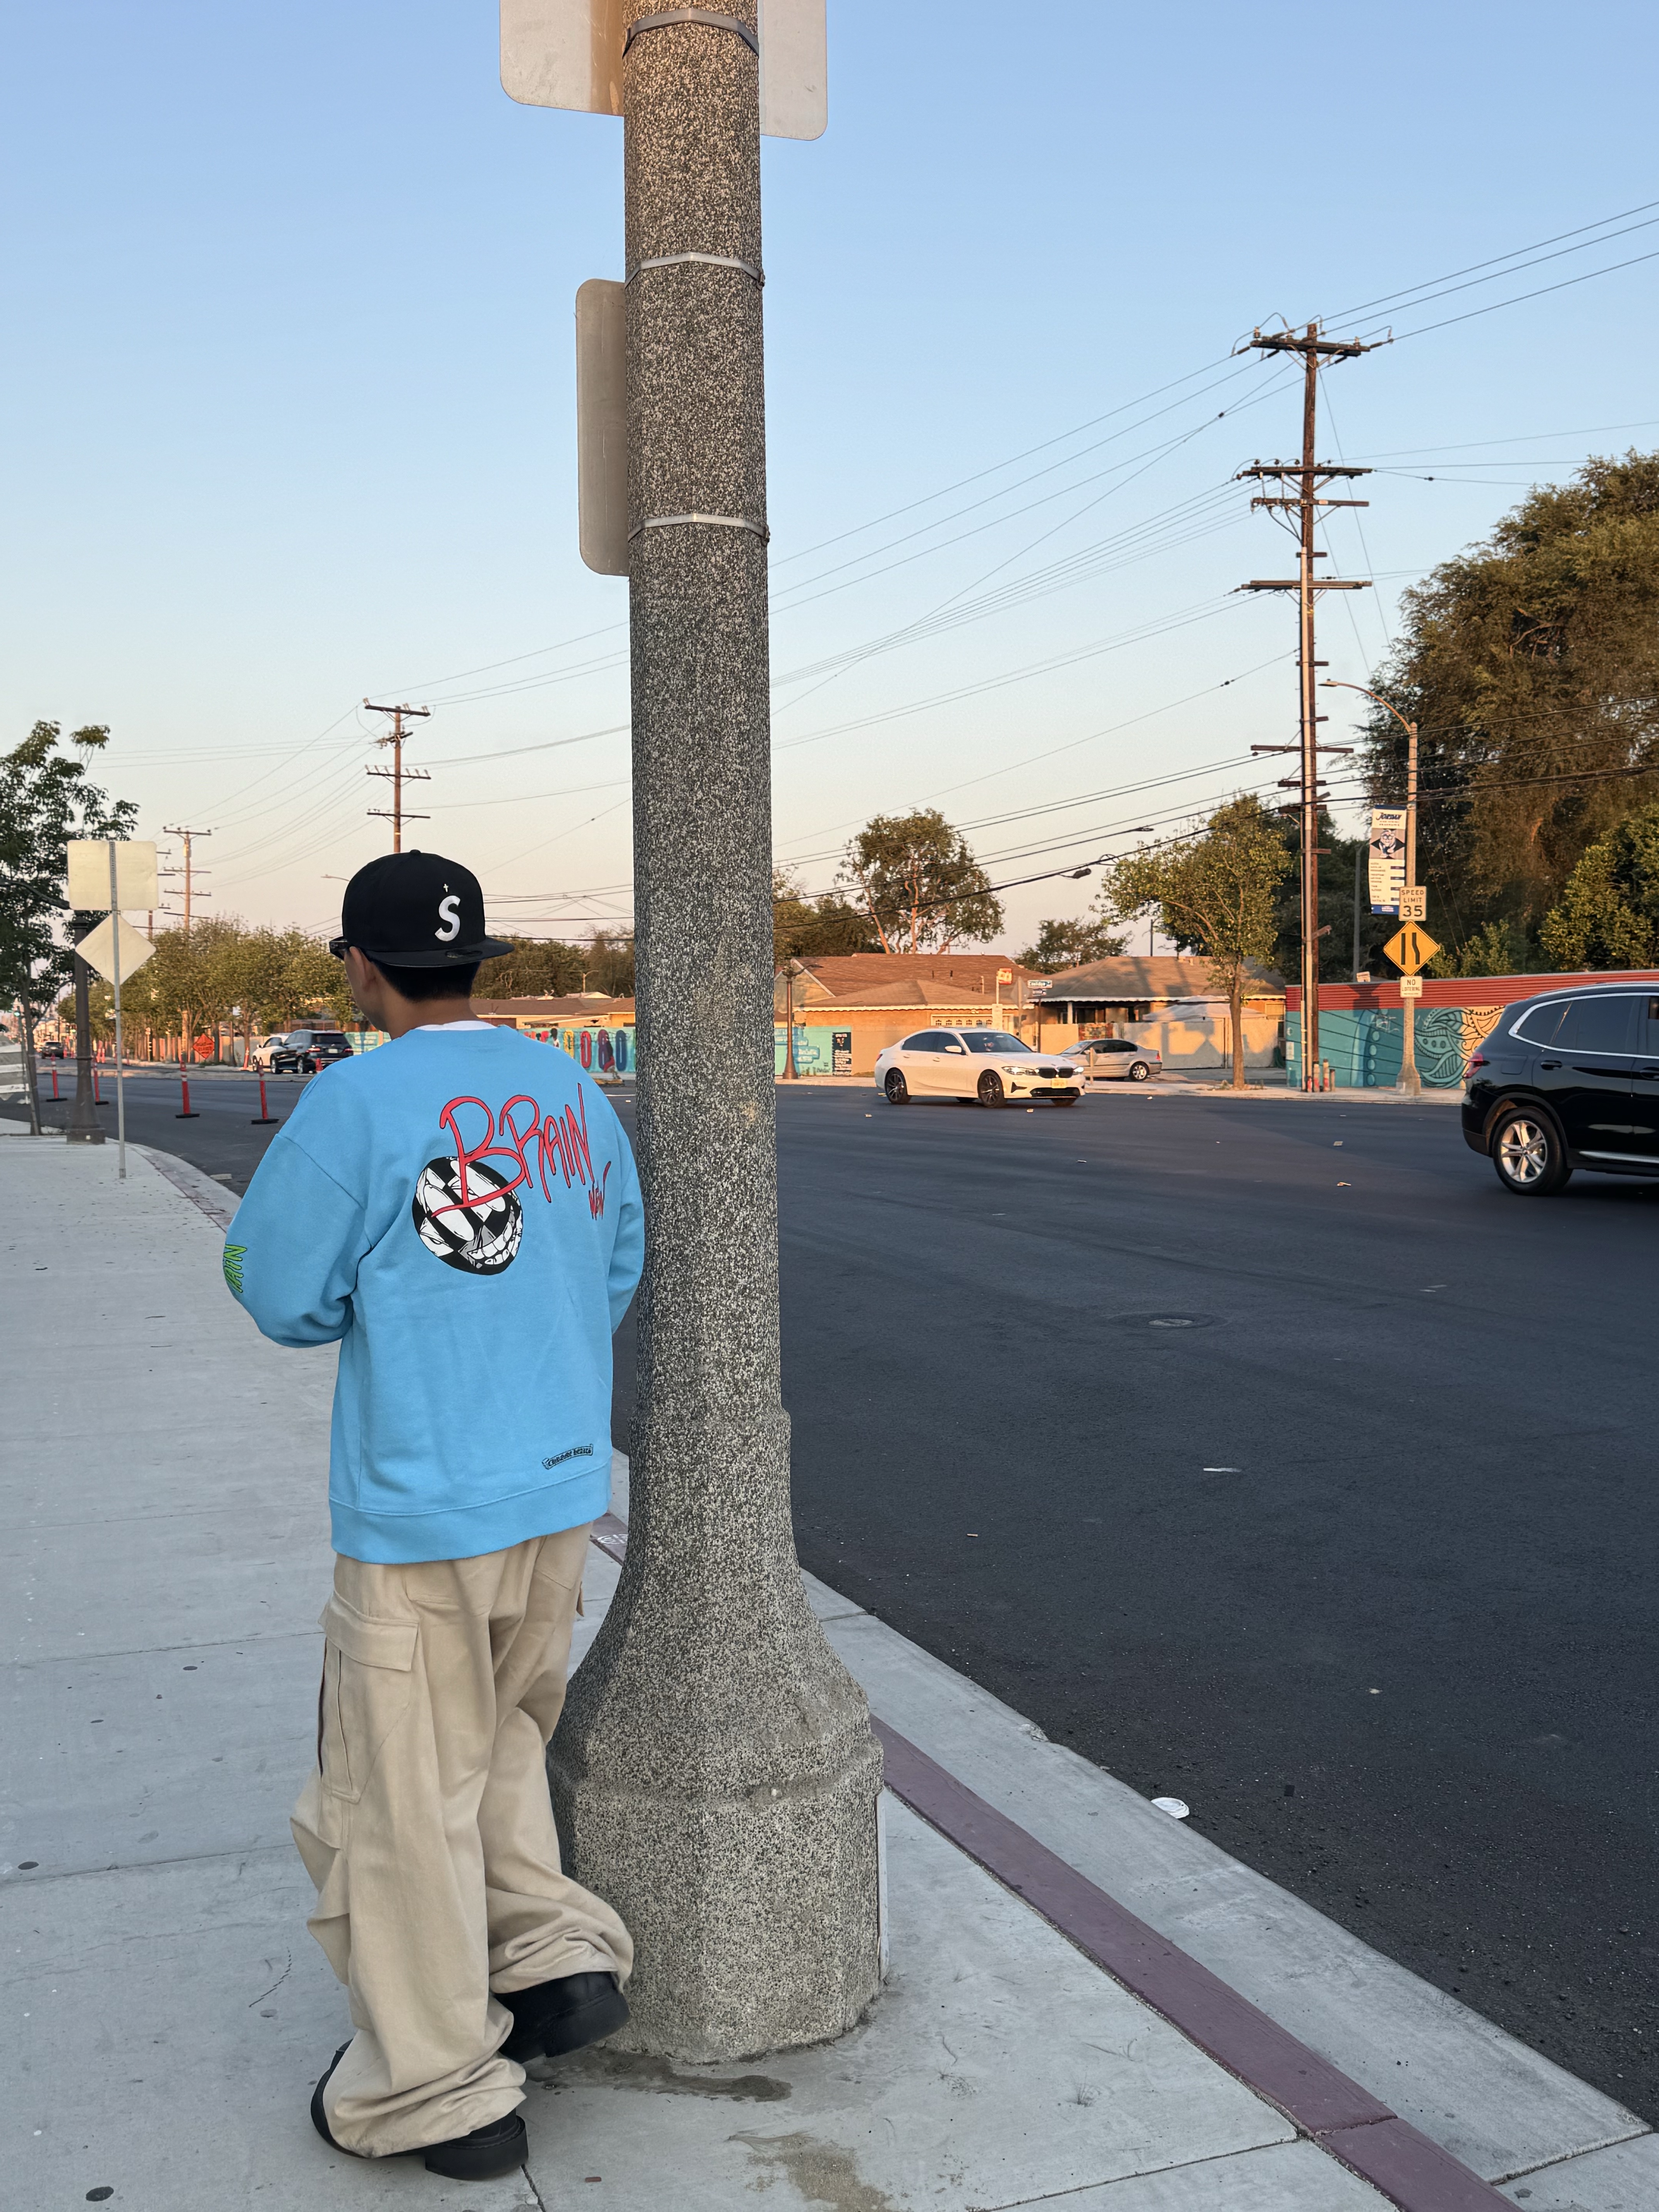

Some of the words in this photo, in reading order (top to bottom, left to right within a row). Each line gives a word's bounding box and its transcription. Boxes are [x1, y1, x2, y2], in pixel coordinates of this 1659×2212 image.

[434, 895, 460, 942] S
[1403, 905, 1423, 917] 35
[431, 1083, 595, 1218] BRAIN
